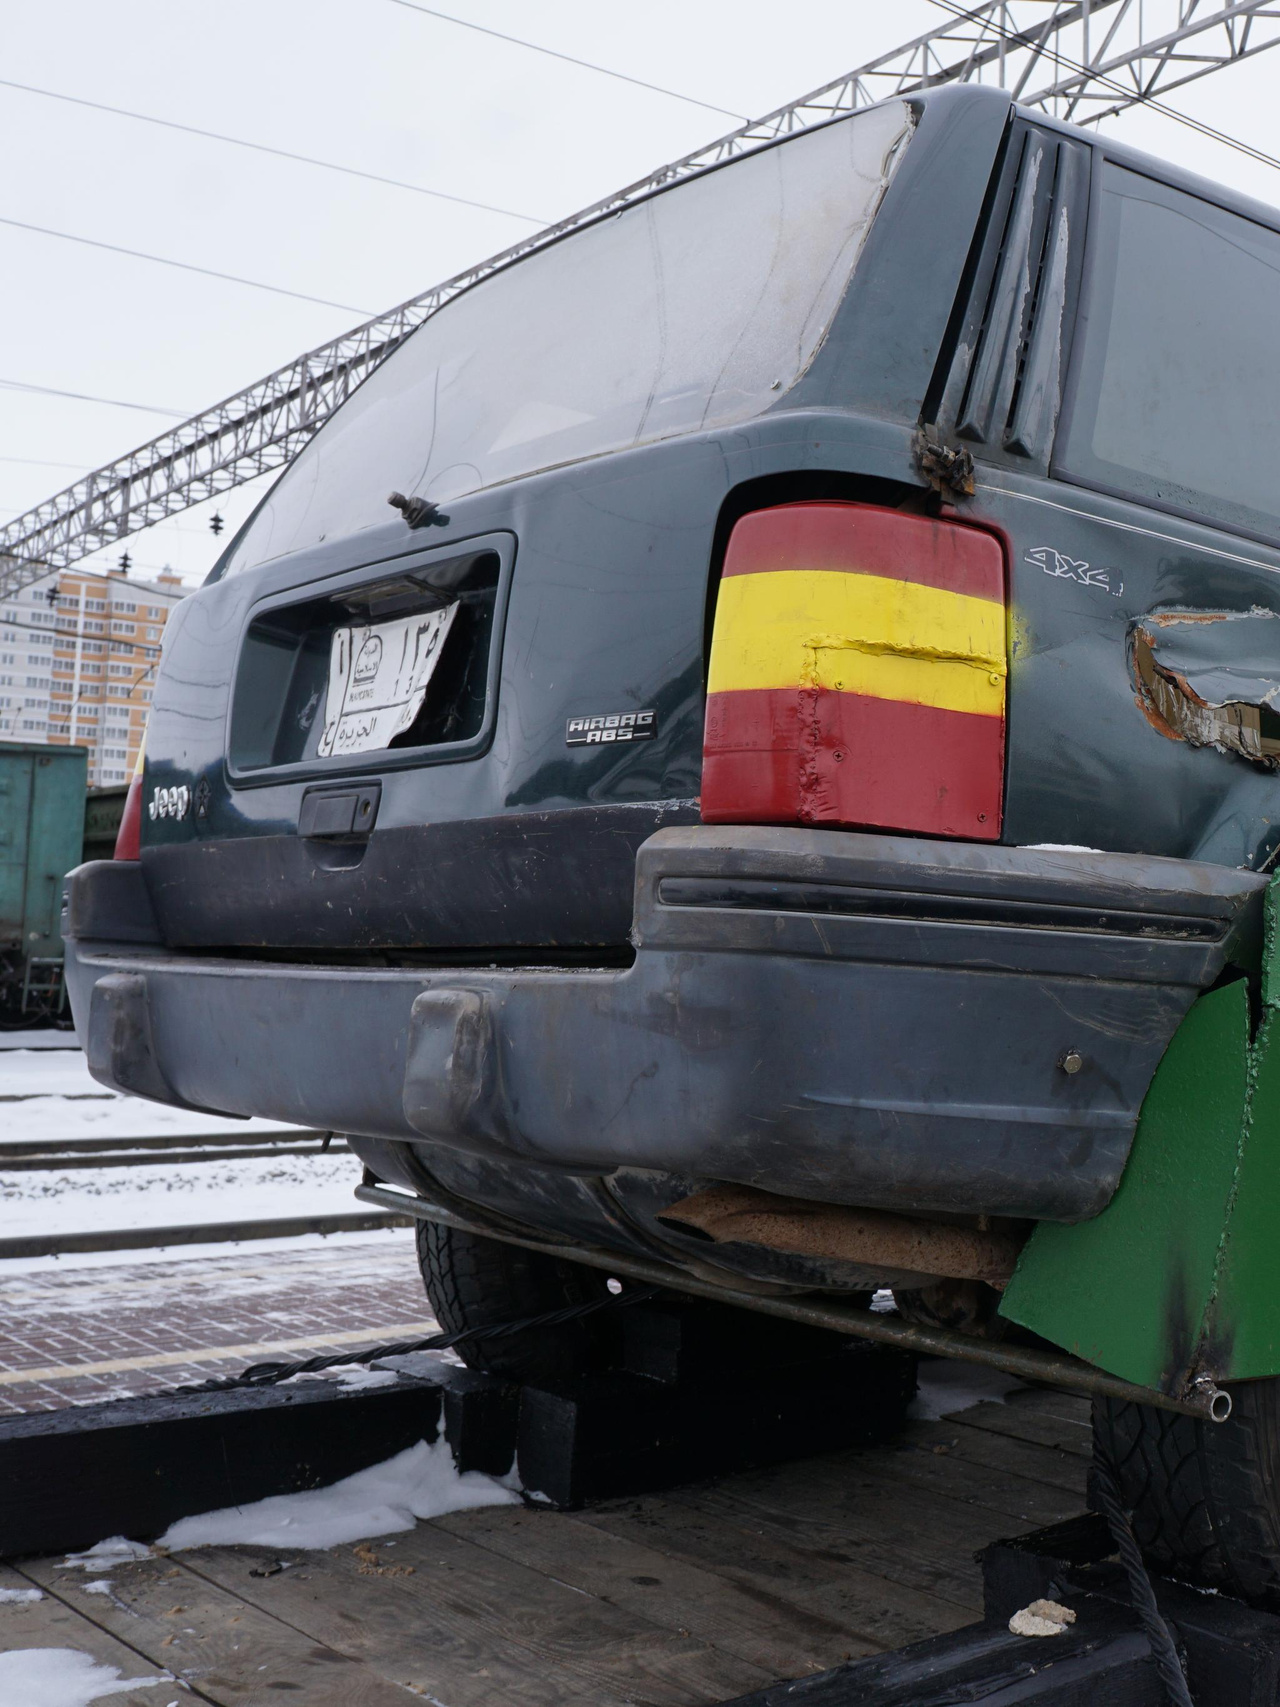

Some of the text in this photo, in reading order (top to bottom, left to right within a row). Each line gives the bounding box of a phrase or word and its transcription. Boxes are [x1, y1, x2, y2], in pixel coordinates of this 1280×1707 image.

[569, 712, 654, 732] AIRBAG
[586, 727, 634, 743] ABS
[148, 785, 190, 821] Jeep
